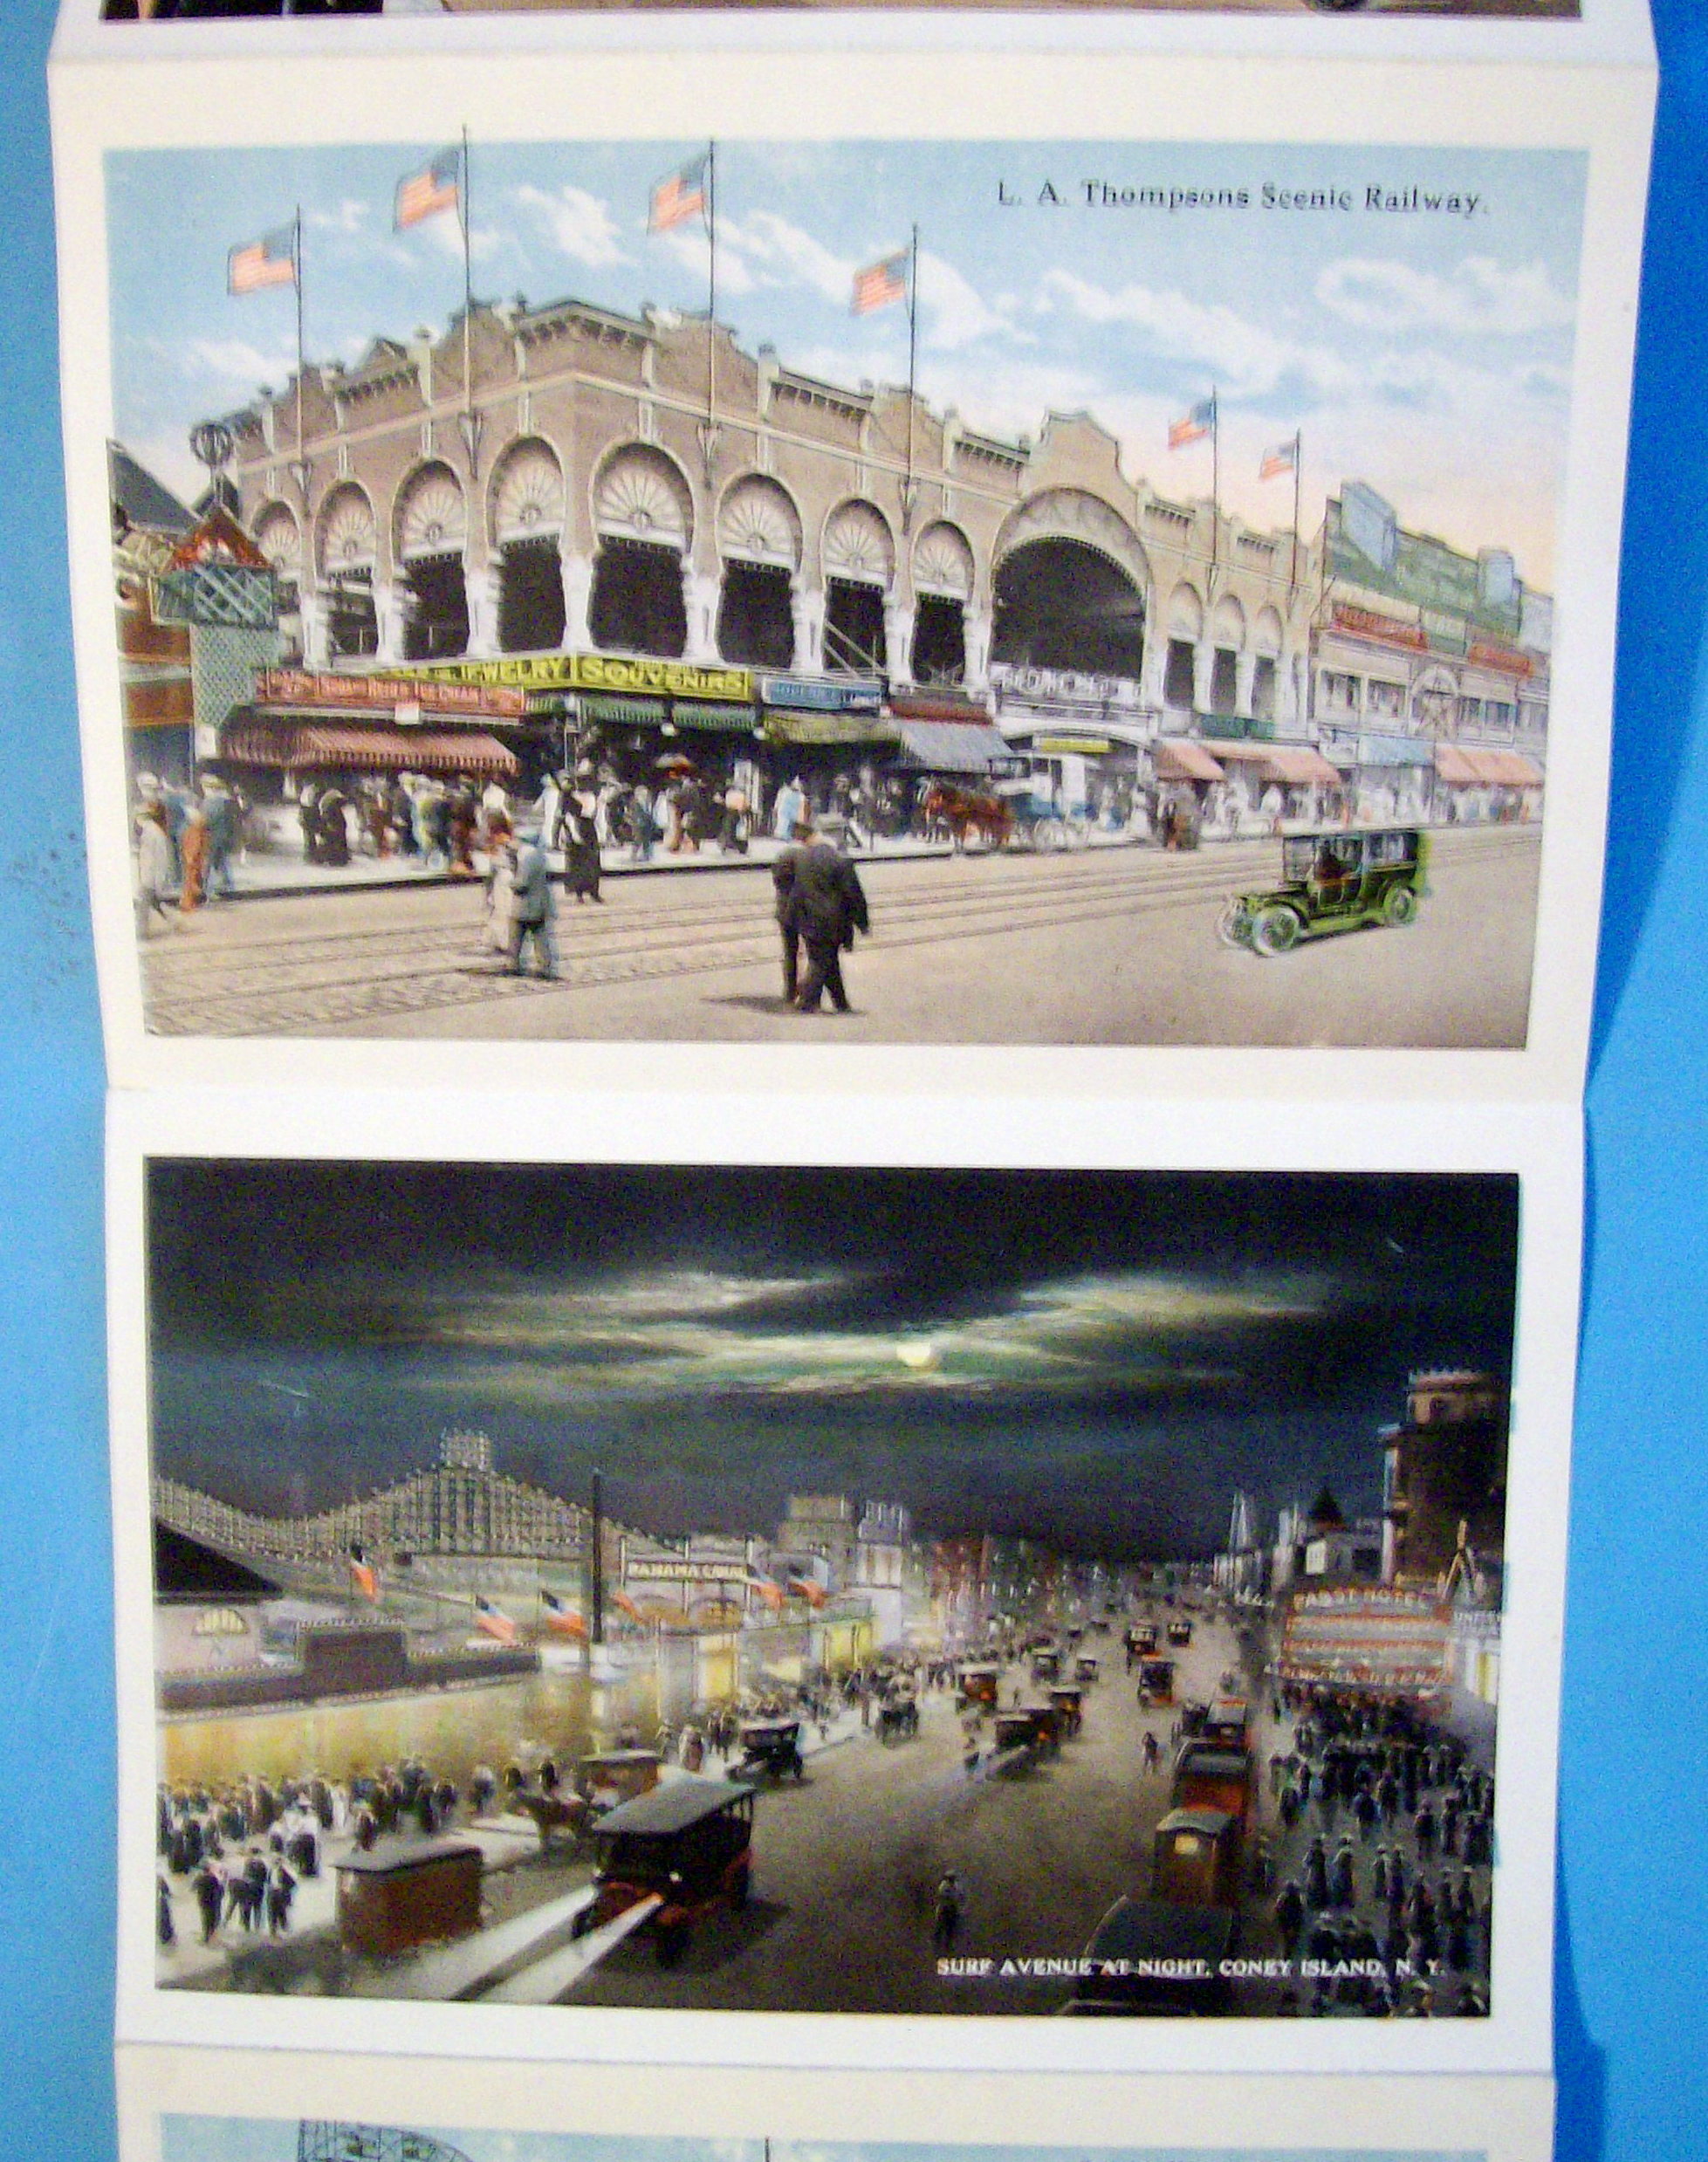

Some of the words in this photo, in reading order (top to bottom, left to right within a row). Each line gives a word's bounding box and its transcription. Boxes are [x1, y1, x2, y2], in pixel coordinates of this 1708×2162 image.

[998, 179, 1022, 206] L.
[1038, 178, 1067, 207] A.
[1081, 178, 1251, 212] Thompsons
[1261, 182, 1354, 211] Scenic
[1364, 184, 1490, 219] Railway.
[936, 1958, 992, 1976] SURF
[999, 1958, 1092, 1977] AVENUE
[1101, 1959, 1132, 1977] AT
[1218, 1960, 1293, 1977] CONEY
[1396, 1960, 1417, 1977] N.
[1425, 1960, 1445, 1978] Y.
